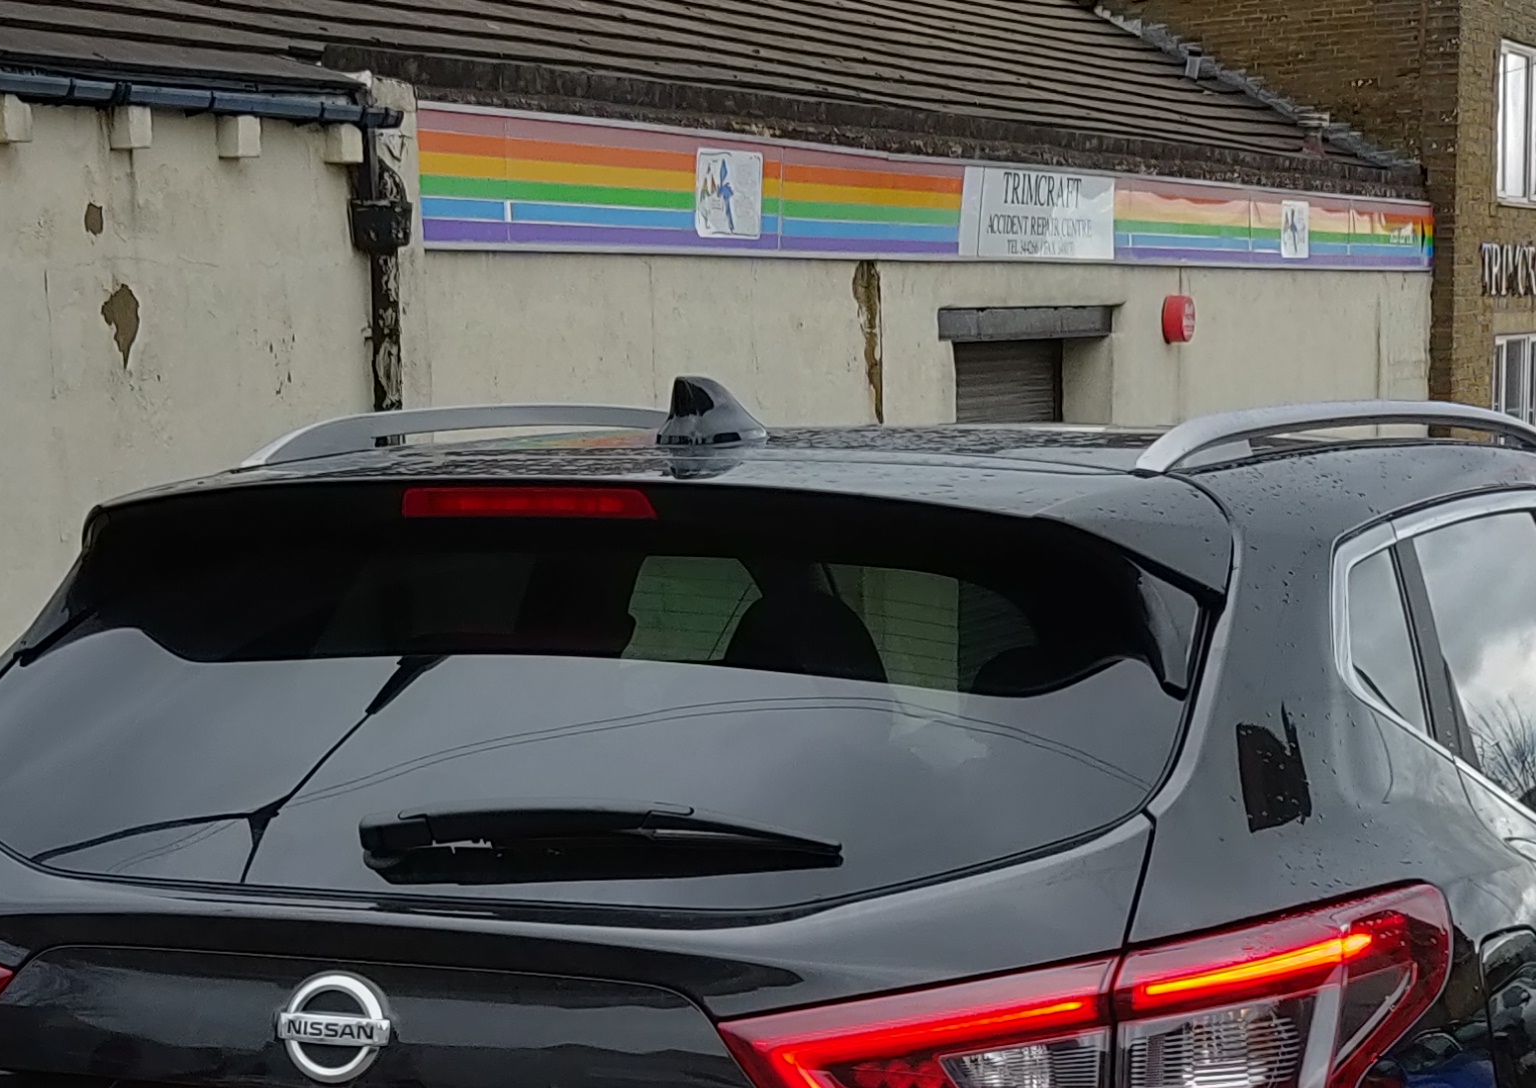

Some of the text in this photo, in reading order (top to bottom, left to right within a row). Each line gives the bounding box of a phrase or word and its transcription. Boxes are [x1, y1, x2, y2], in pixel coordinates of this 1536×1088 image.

[1004, 172, 1082, 209] TRIMCRAFT
[986, 213, 1093, 239] ACCIDENT REPAIR CENTRE
[287, 1019, 374, 1040] NISSAN
